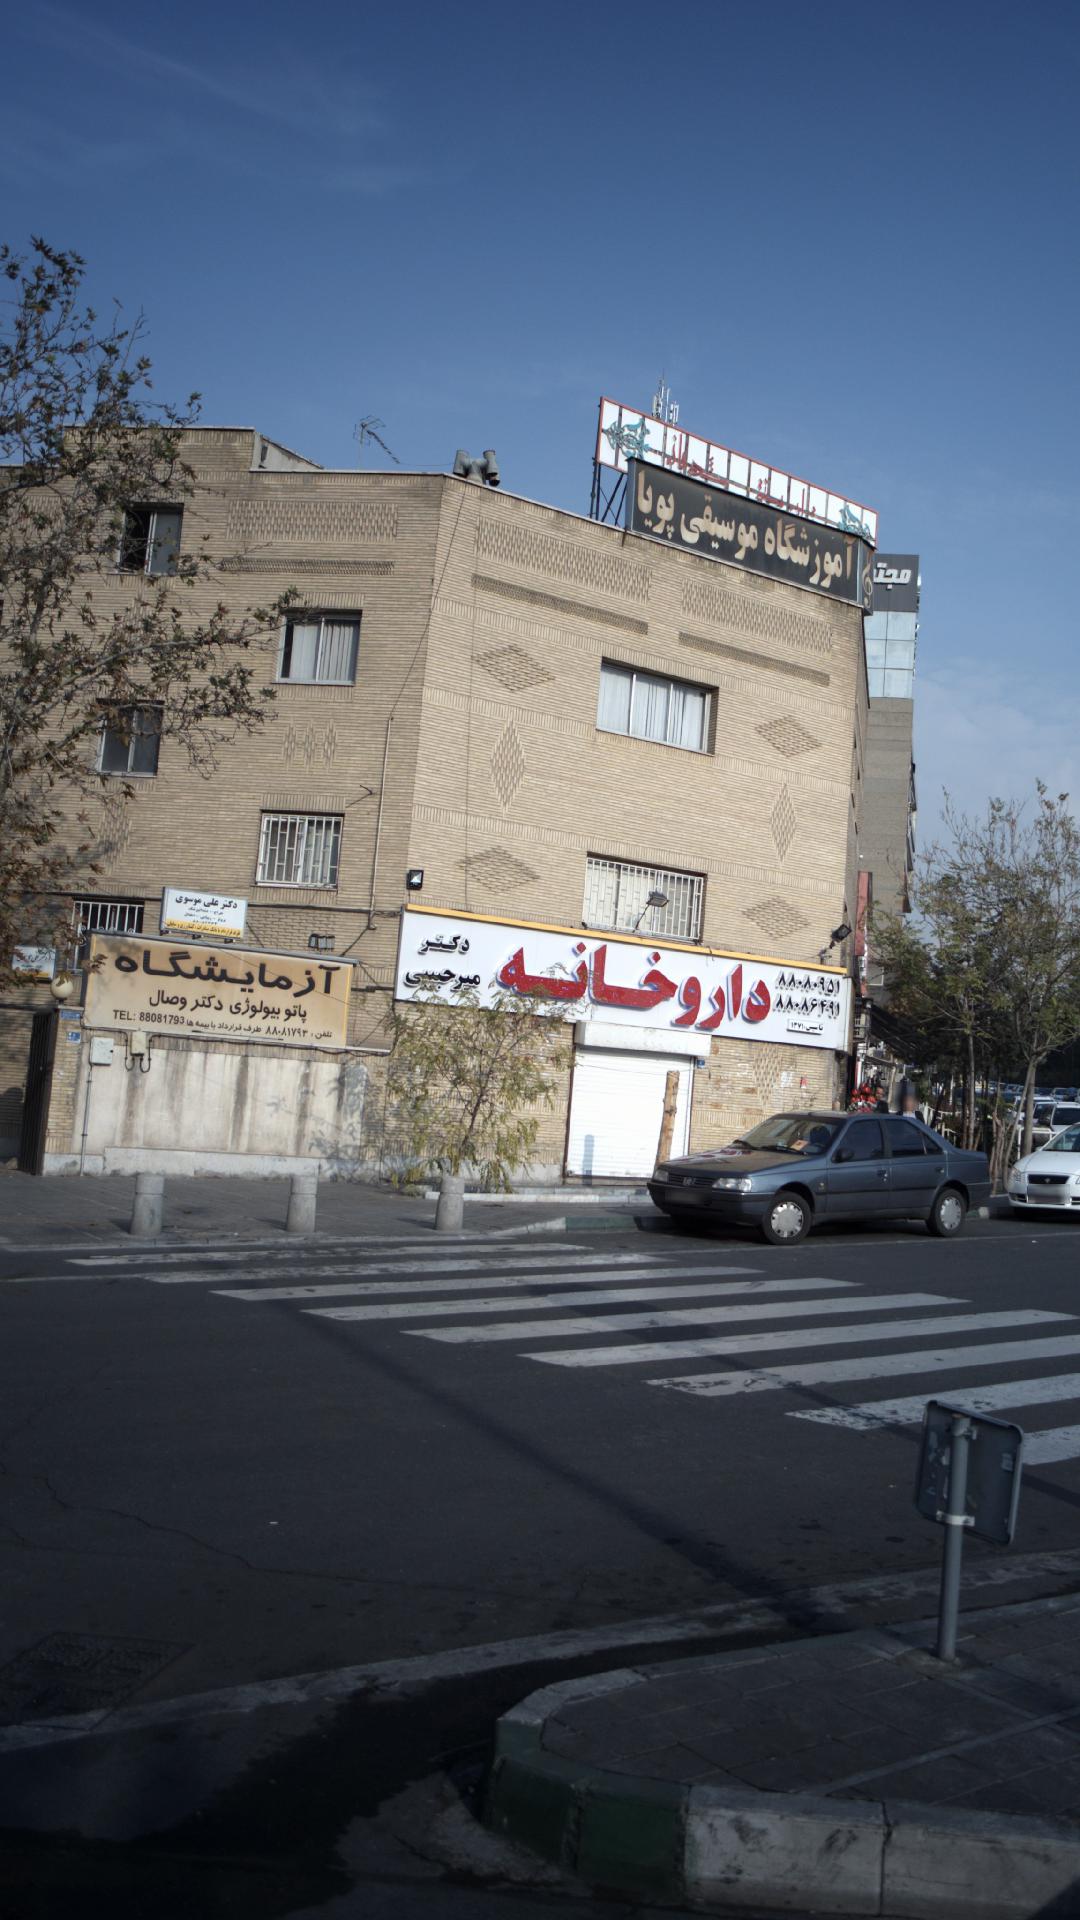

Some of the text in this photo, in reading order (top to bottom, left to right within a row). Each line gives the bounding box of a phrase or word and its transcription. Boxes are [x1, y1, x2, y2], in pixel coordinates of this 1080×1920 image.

[638, 470, 674, 538] پویا
[680, 495, 758, 560] موسیقی
[764, 517, 857, 588] آموزشگاه
[873, 562, 911, 589] مجت
[175, 895, 238, 909] دکتر علی موسوی
[420, 933, 470, 954] دکتر
[115, 950, 340, 997] آزمایشگاه
[496, 941, 771, 1030] داروخانه
[777, 971, 840, 994] ۸۸۰۸۰۹۵۱
[113, 1010, 185, 1025] TEL: 88081793
[149, 989, 307, 1023] پاتو بیولوژی دکتر وصال
[776, 993, 840, 1017] ۸۸۰۸۶۴۹۱
